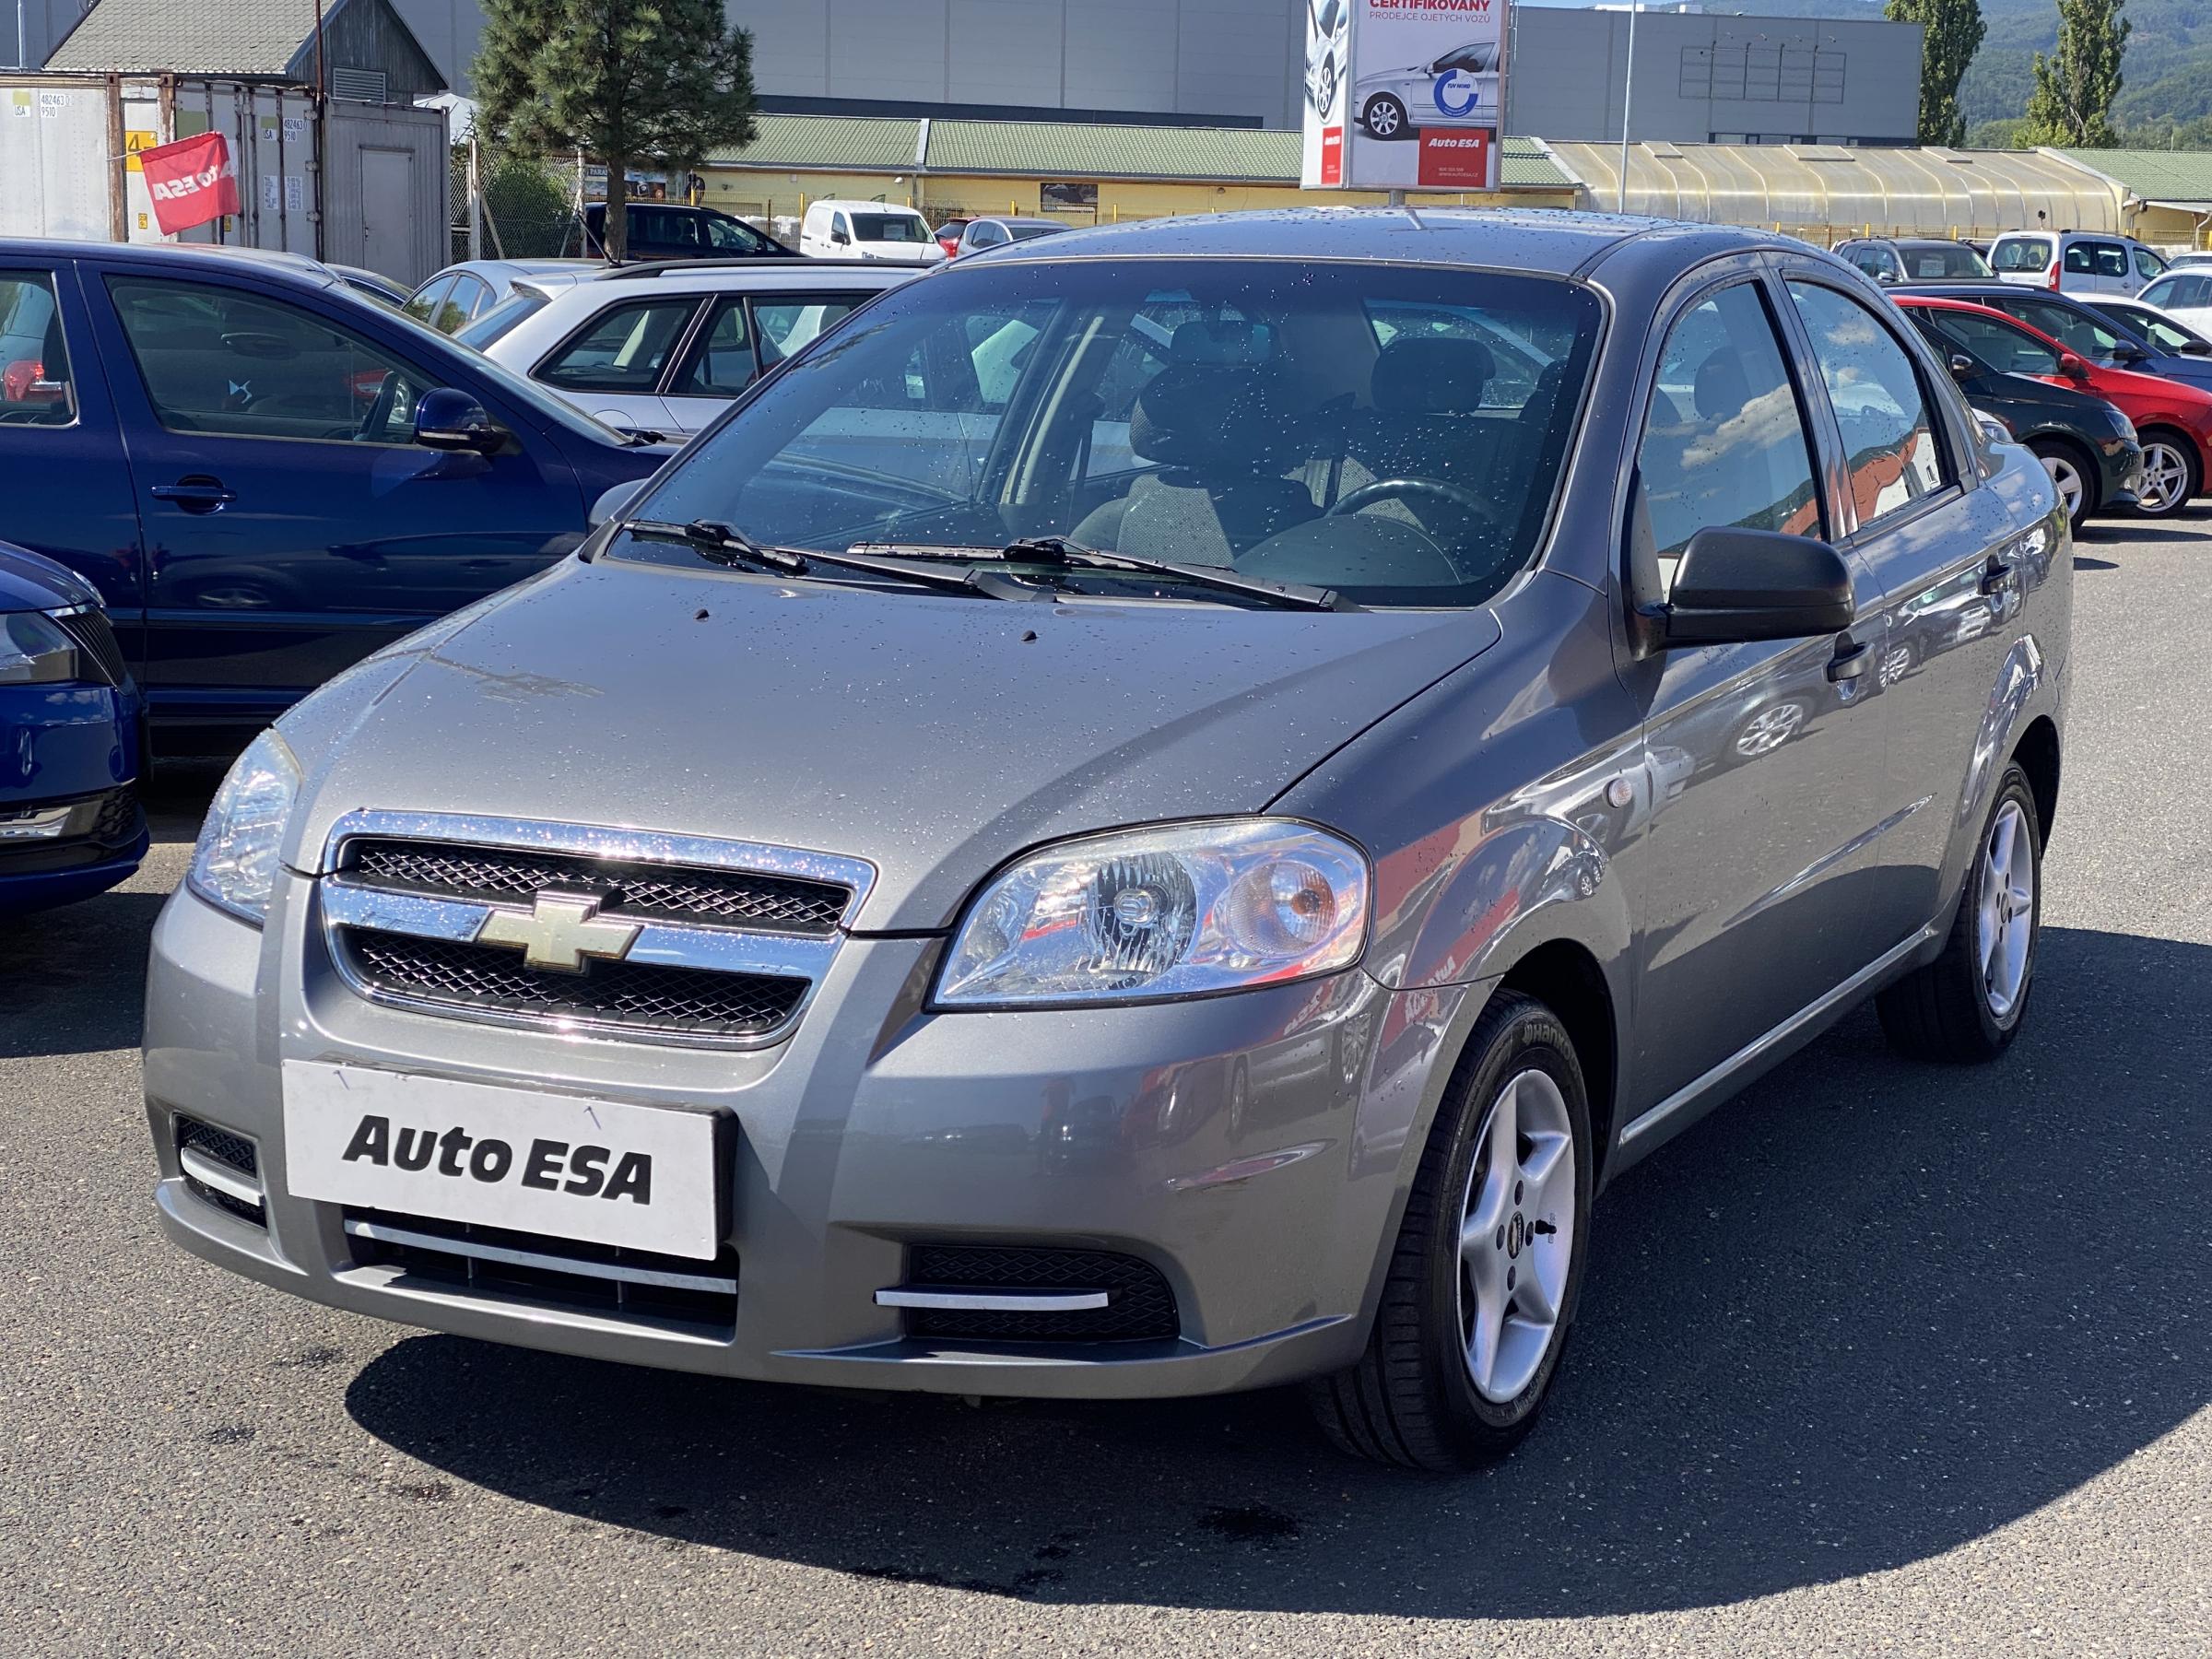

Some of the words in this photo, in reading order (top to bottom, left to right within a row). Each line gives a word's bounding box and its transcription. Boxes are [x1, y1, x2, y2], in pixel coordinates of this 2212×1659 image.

[1370, 11, 1418, 21] PRODEJCE
[1465, 13, 1490, 23] VOZŮ
[14, 106, 26, 116] USA
[41, 106, 56, 117] 9510
[1429, 137, 1457, 147] Auto
[1458, 138, 1480, 148] ESA
[342, 1114, 512, 1183] Auto
[521, 1138, 653, 1206] ESA
